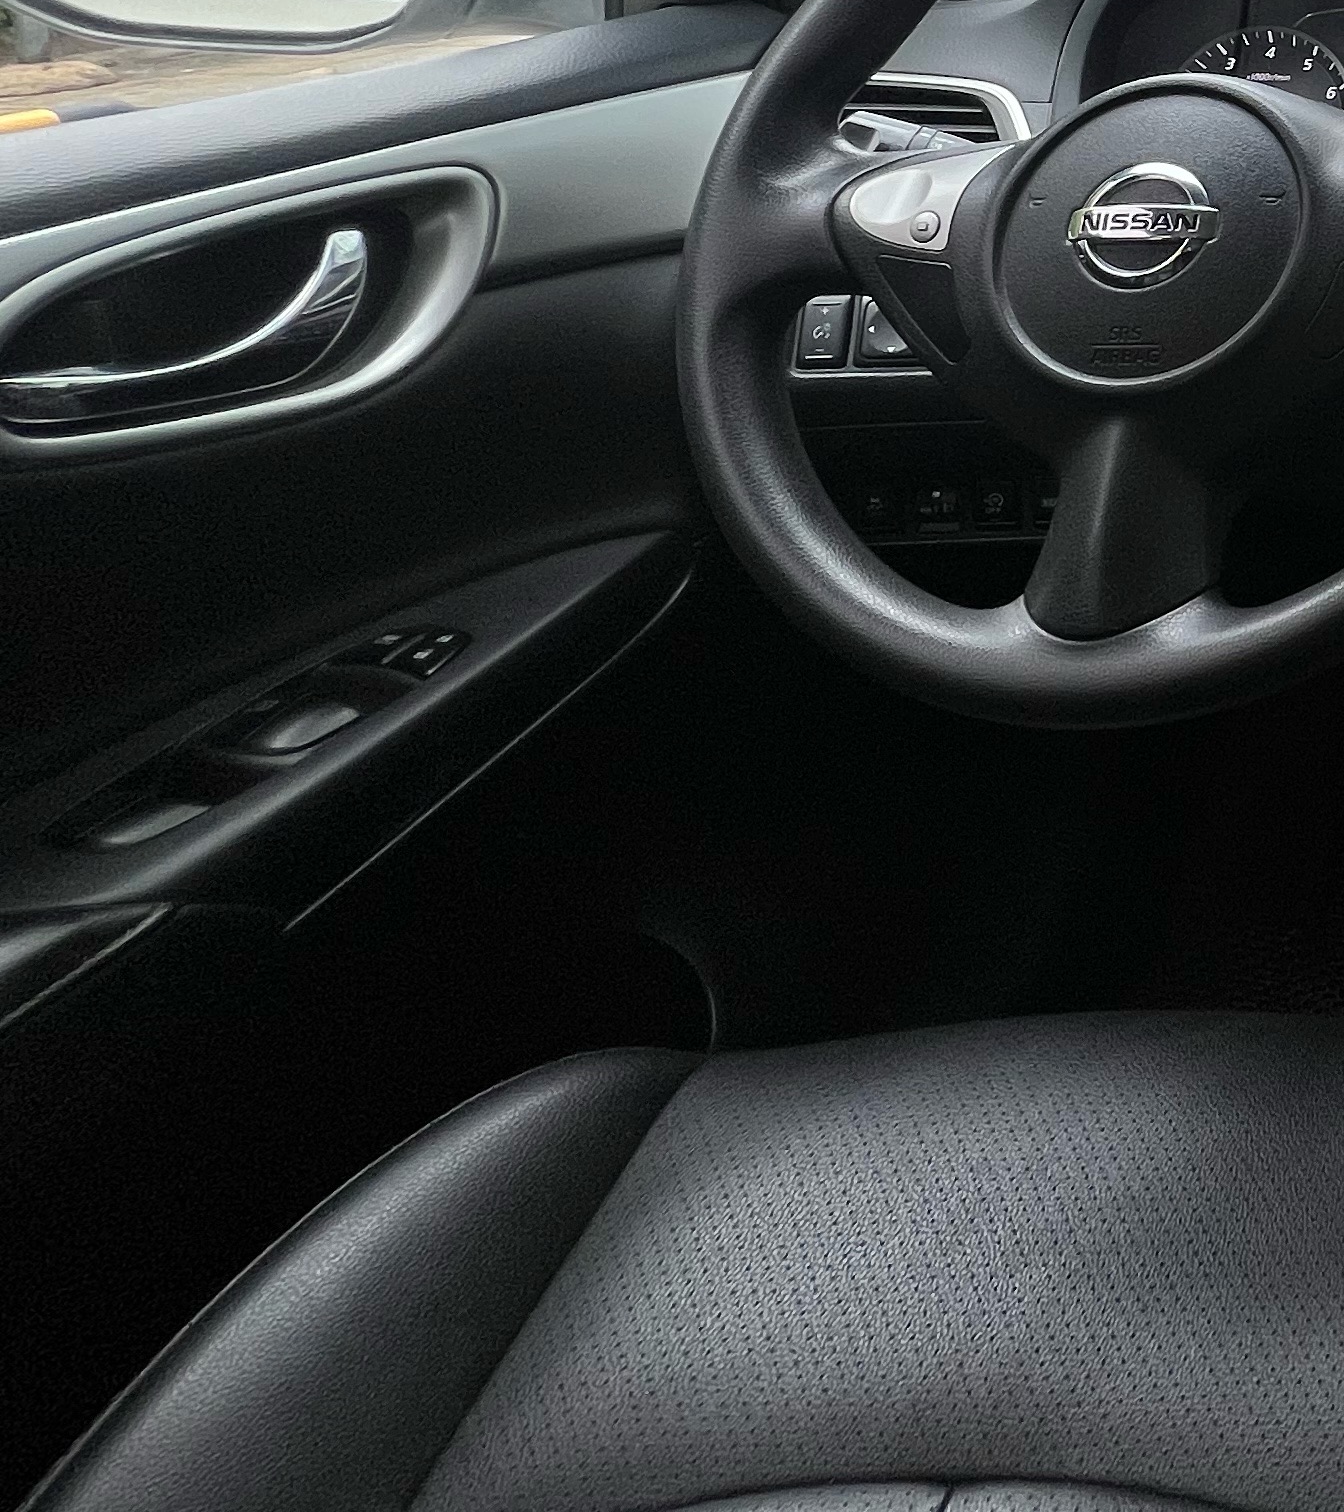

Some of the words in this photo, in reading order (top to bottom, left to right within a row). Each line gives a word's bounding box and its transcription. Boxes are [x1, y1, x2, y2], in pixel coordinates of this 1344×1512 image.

[1265, 47, 1276, 58] 4
[1224, 58, 1236, 70] 3
[1302, 59, 1313, 71] 5
[1326, 86, 1337, 99] 6
[1080, 212, 1202, 235] NISSAN
[1109, 325, 1142, 341] SRS
[1090, 347, 1161, 365] AIRBAG
